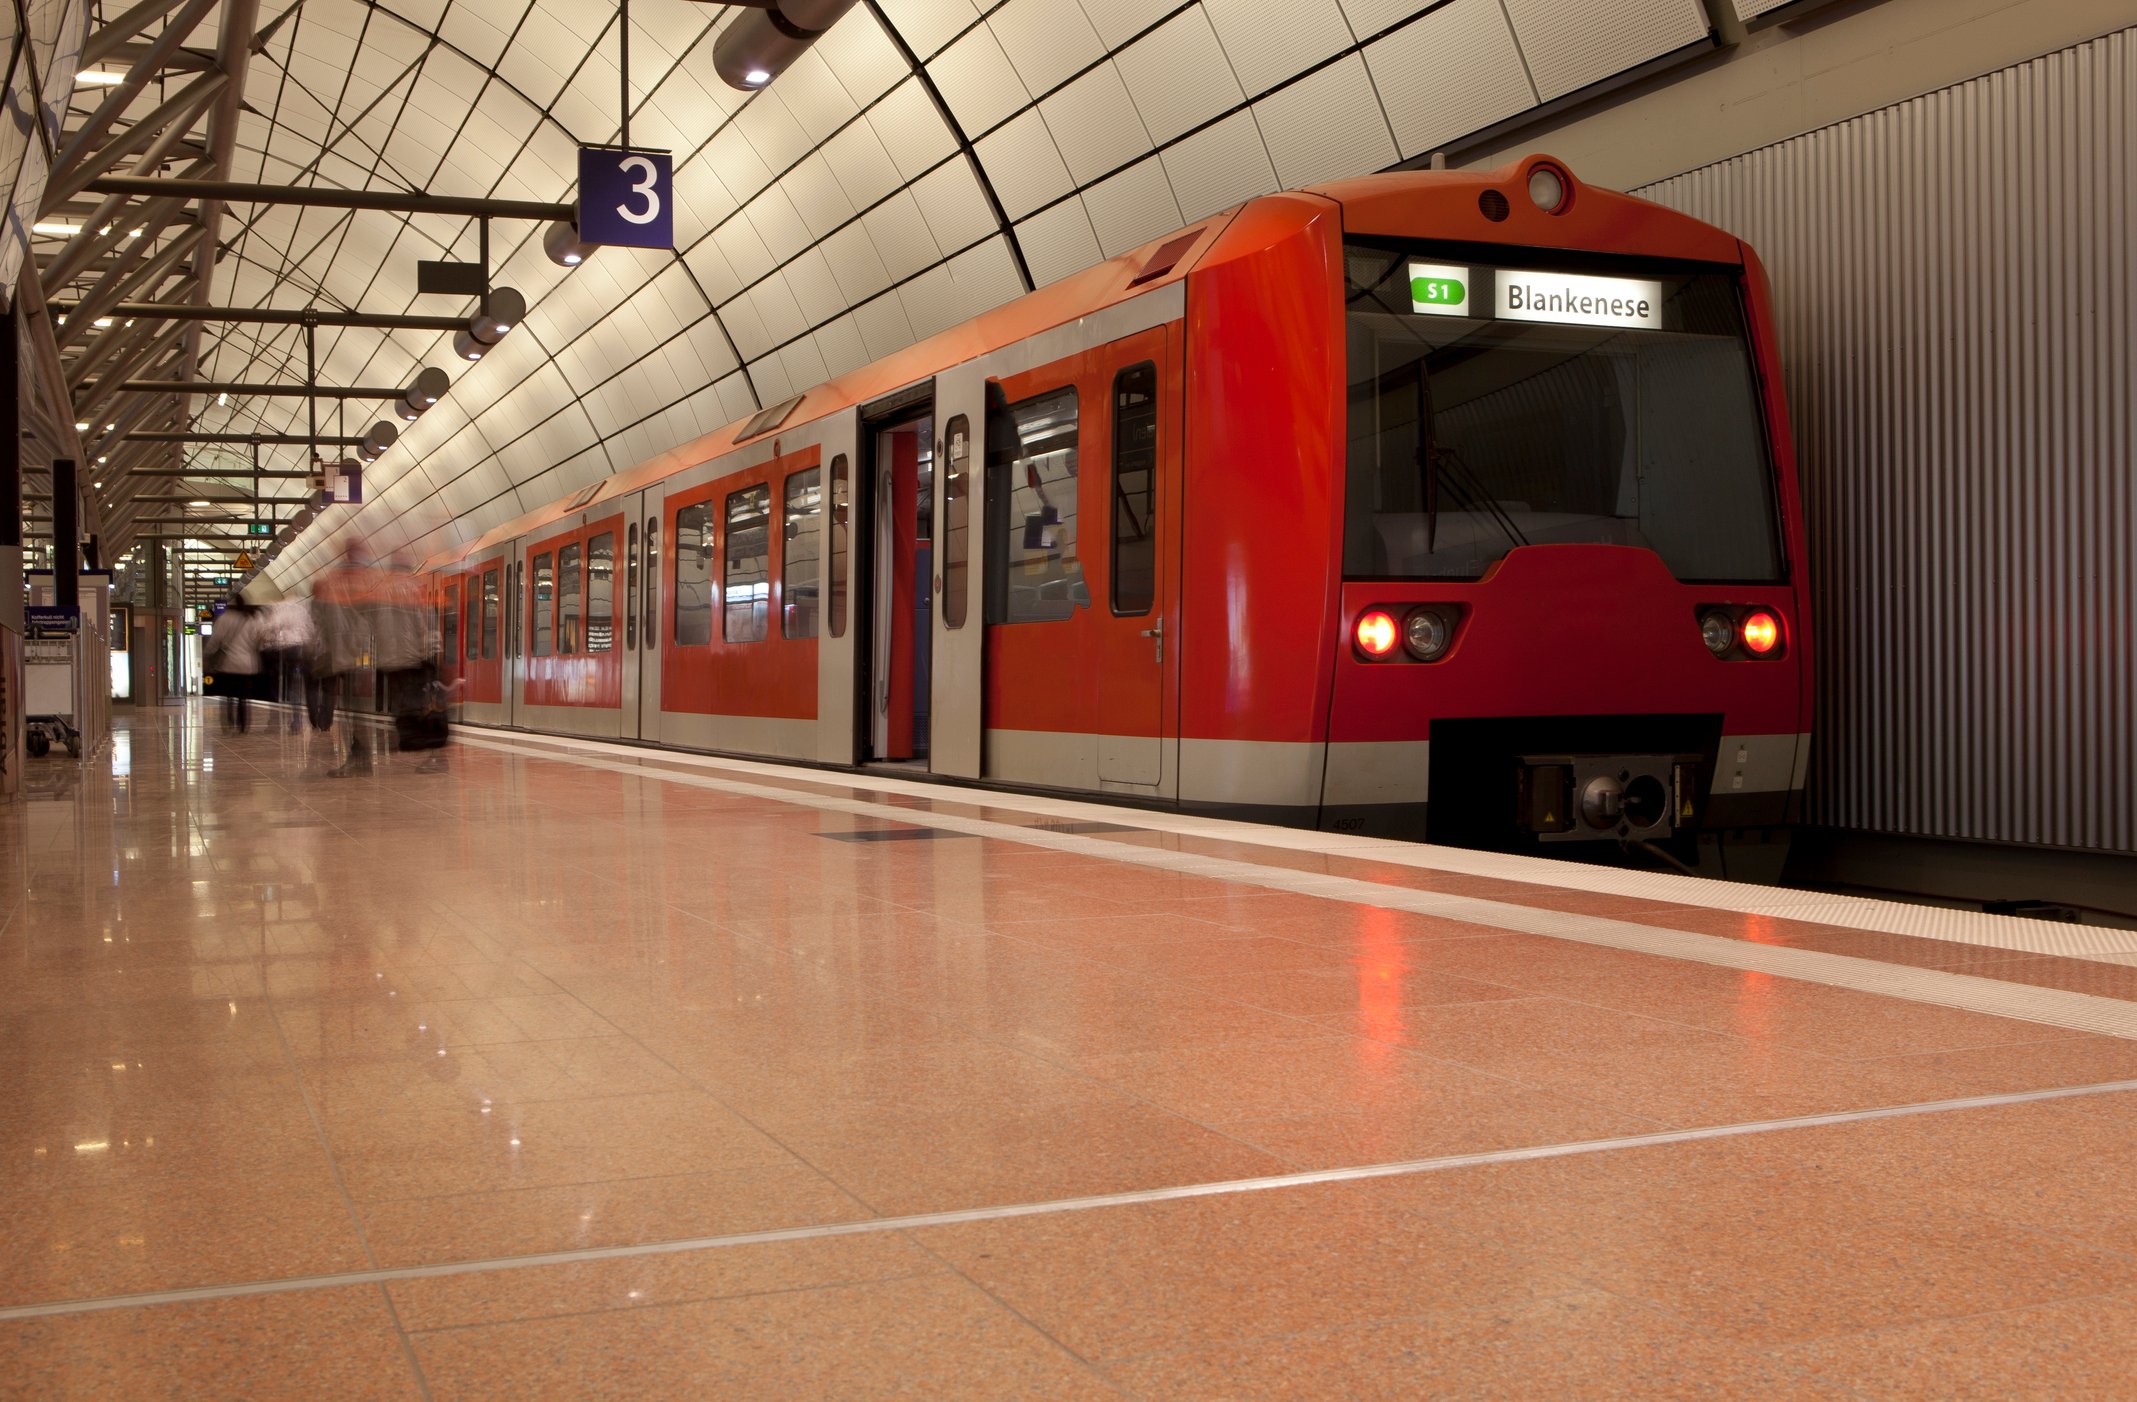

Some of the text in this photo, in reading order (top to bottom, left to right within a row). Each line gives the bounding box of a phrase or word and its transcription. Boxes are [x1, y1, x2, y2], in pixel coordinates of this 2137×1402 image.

[616, 156, 660, 224] 3
[1508, 284, 1650, 318] Blankenese
[1333, 818, 1366, 830] 4507
